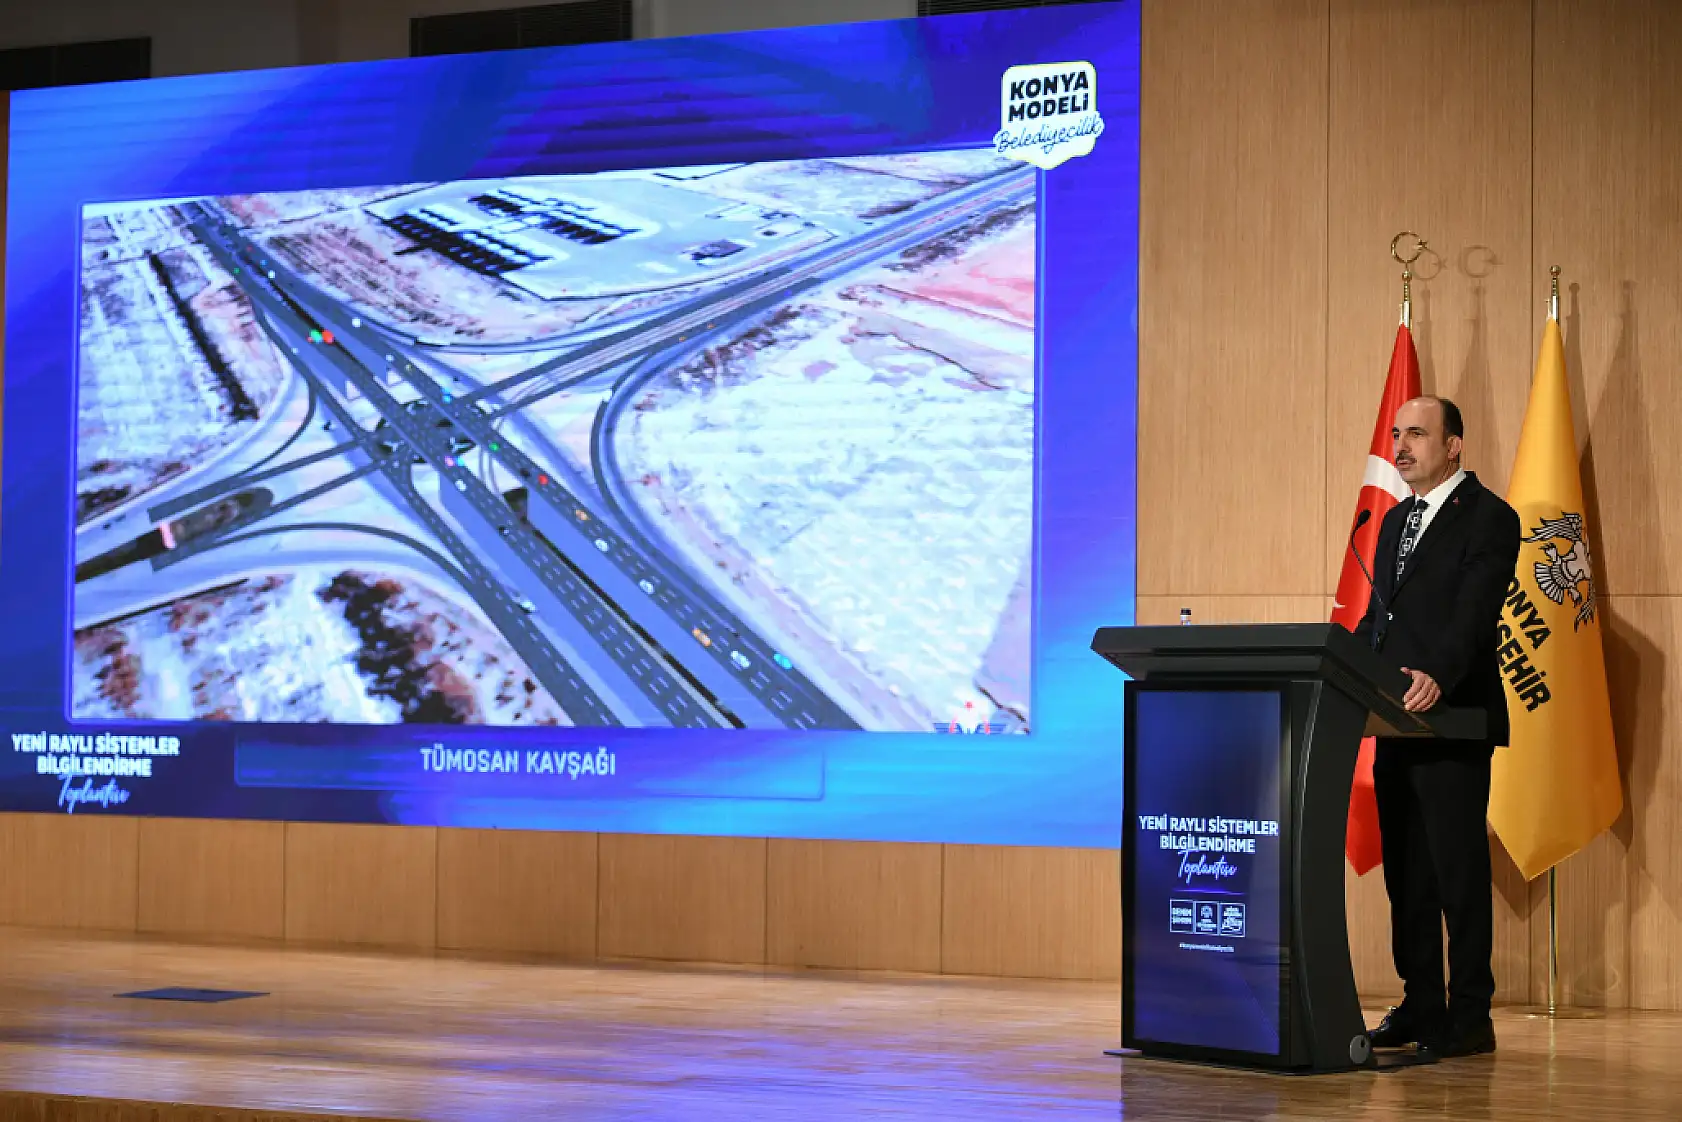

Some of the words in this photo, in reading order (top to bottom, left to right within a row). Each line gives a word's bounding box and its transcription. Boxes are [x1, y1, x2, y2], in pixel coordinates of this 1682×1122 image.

[1009, 71, 1089, 101] KONYA
[1007, 93, 1089, 122] MODELİ
[997, 114, 1102, 154] Belediyecilik
[1504, 577, 1552, 650] ONYA
[11, 731, 47, 752] YENİ
[50, 733, 94, 754] RAYLI
[95, 732, 181, 756] SİSTEMLER
[36, 753, 153, 777] BİLGİLENDİRME
[420, 743, 519, 773] TÜMOSAN
[526, 746, 616, 780] KAVŞAĞI
[1139, 813, 1168, 830] YENİ
[1169, 817, 1207, 833] RAYLI
[1208, 815, 1279, 836] SİSTEMLER
[1159, 832, 1256, 853] BİLGİLENDİRME
